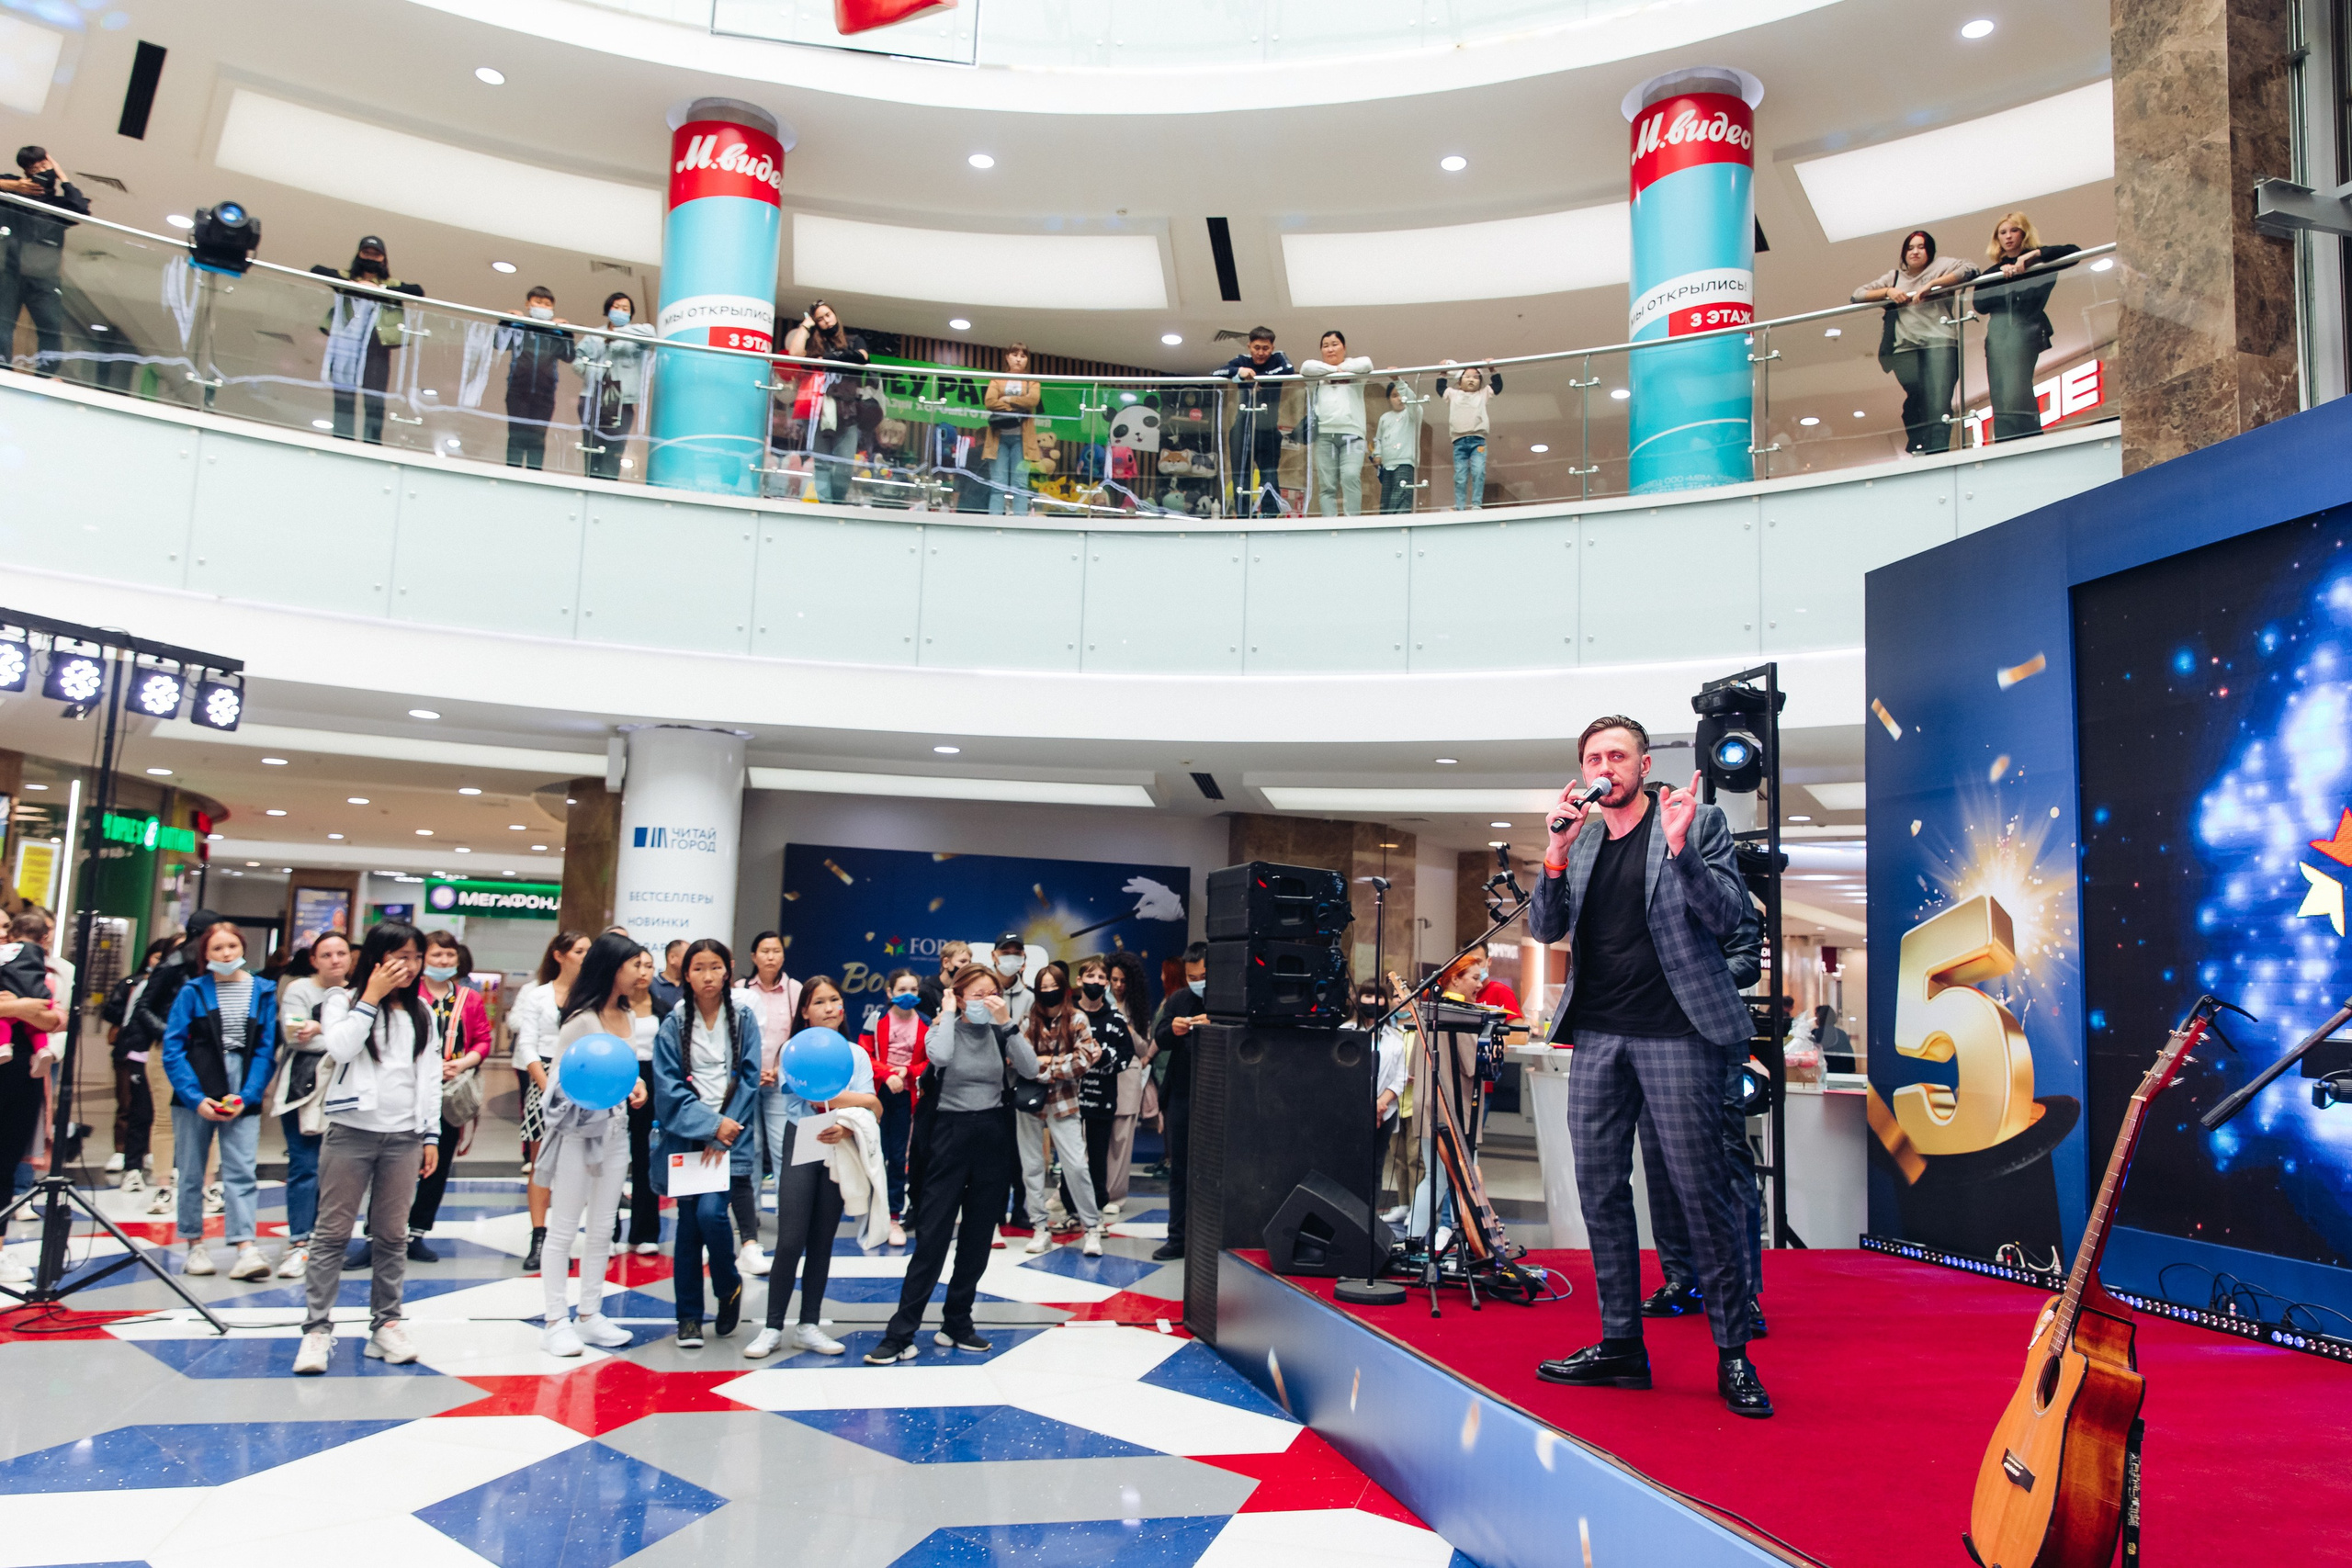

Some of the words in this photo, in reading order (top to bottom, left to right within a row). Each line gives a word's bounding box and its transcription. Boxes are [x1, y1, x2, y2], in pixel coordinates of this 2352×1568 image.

[1631, 109, 1753, 166] М.видео
[675, 135, 785, 196] М.виде
[1690, 312, 1702, 328] 3
[728, 333, 741, 347] 3
[671, 827, 717, 840] ЧИТАЙ
[671, 839, 717, 852] ГОРОД
[628, 891, 714, 905] БЕСТСЕЛЛЕРЫ
[628, 916, 690, 928] НОВИНКИ
